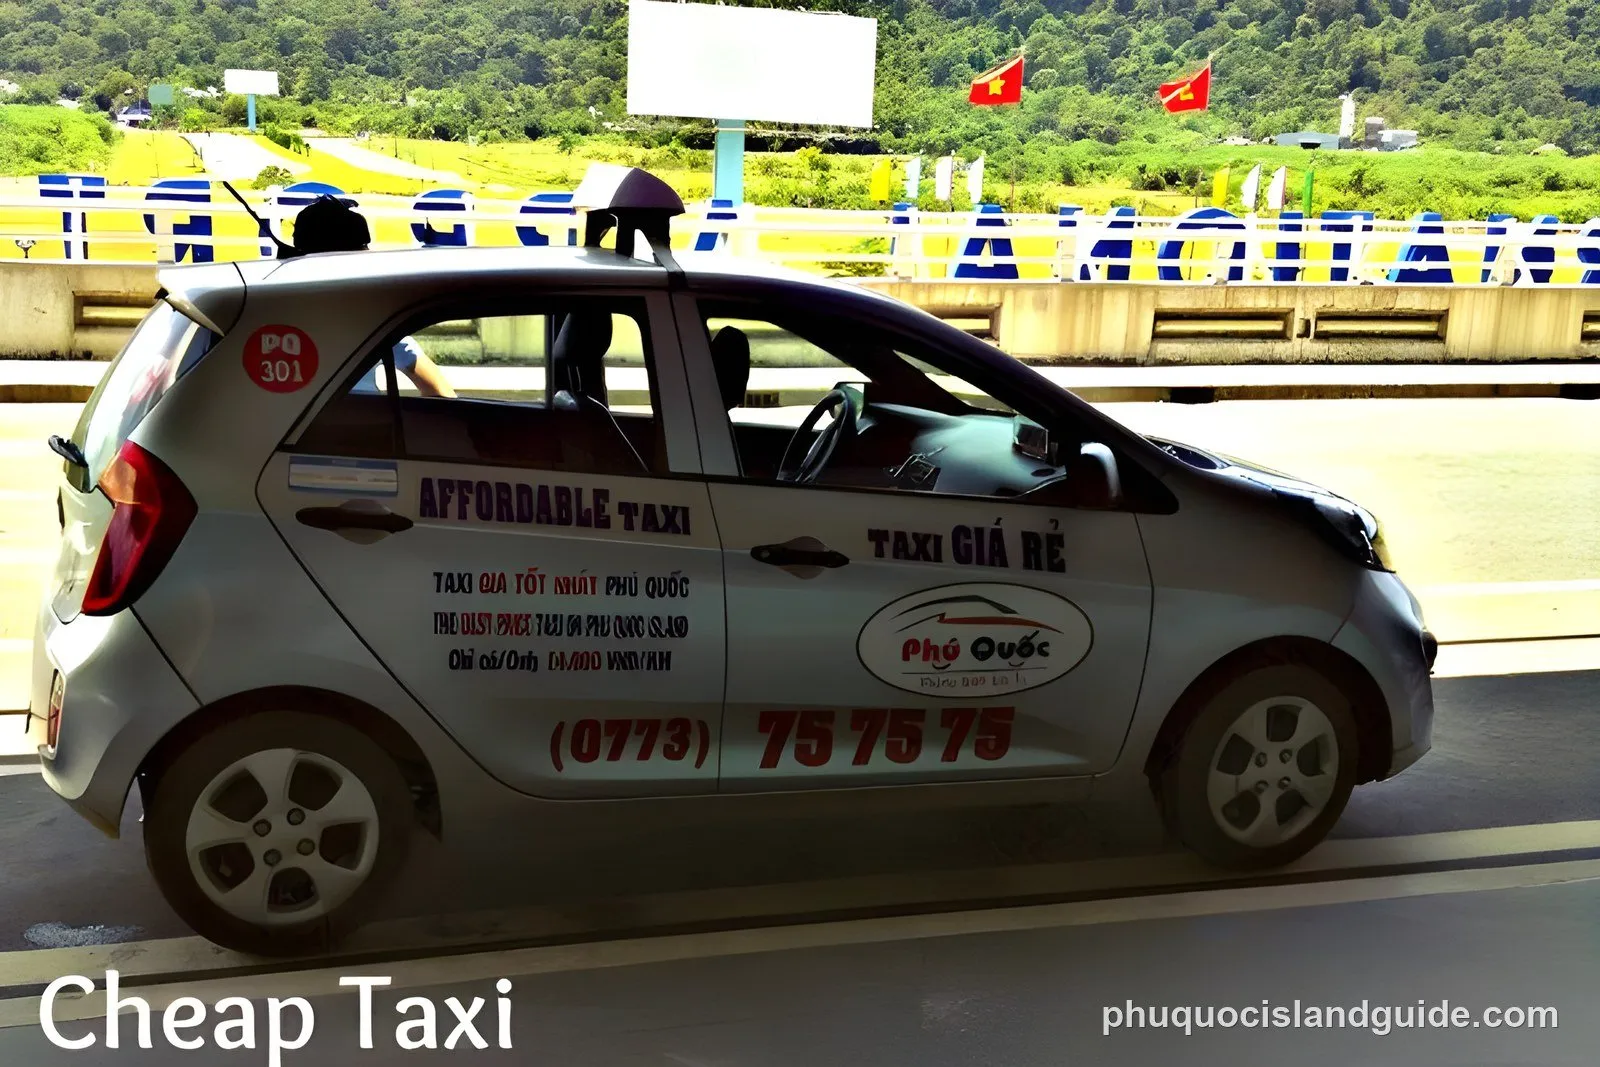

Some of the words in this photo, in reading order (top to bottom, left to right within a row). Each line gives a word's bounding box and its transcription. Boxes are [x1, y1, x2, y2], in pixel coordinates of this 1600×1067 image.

[260, 359, 303, 383] 301
[419, 476, 611, 530] AFFORDABLE
[617, 501, 691, 536] TAXI
[867, 528, 943, 563] TAXI
[951, 517, 1009, 568] GIÁ
[1020, 518, 1066, 573] RẺ
[550, 718, 710, 772] (0773)
[758, 710, 835, 769] 75
[850, 709, 926, 765] 75
[940, 706, 1015, 762] 75
